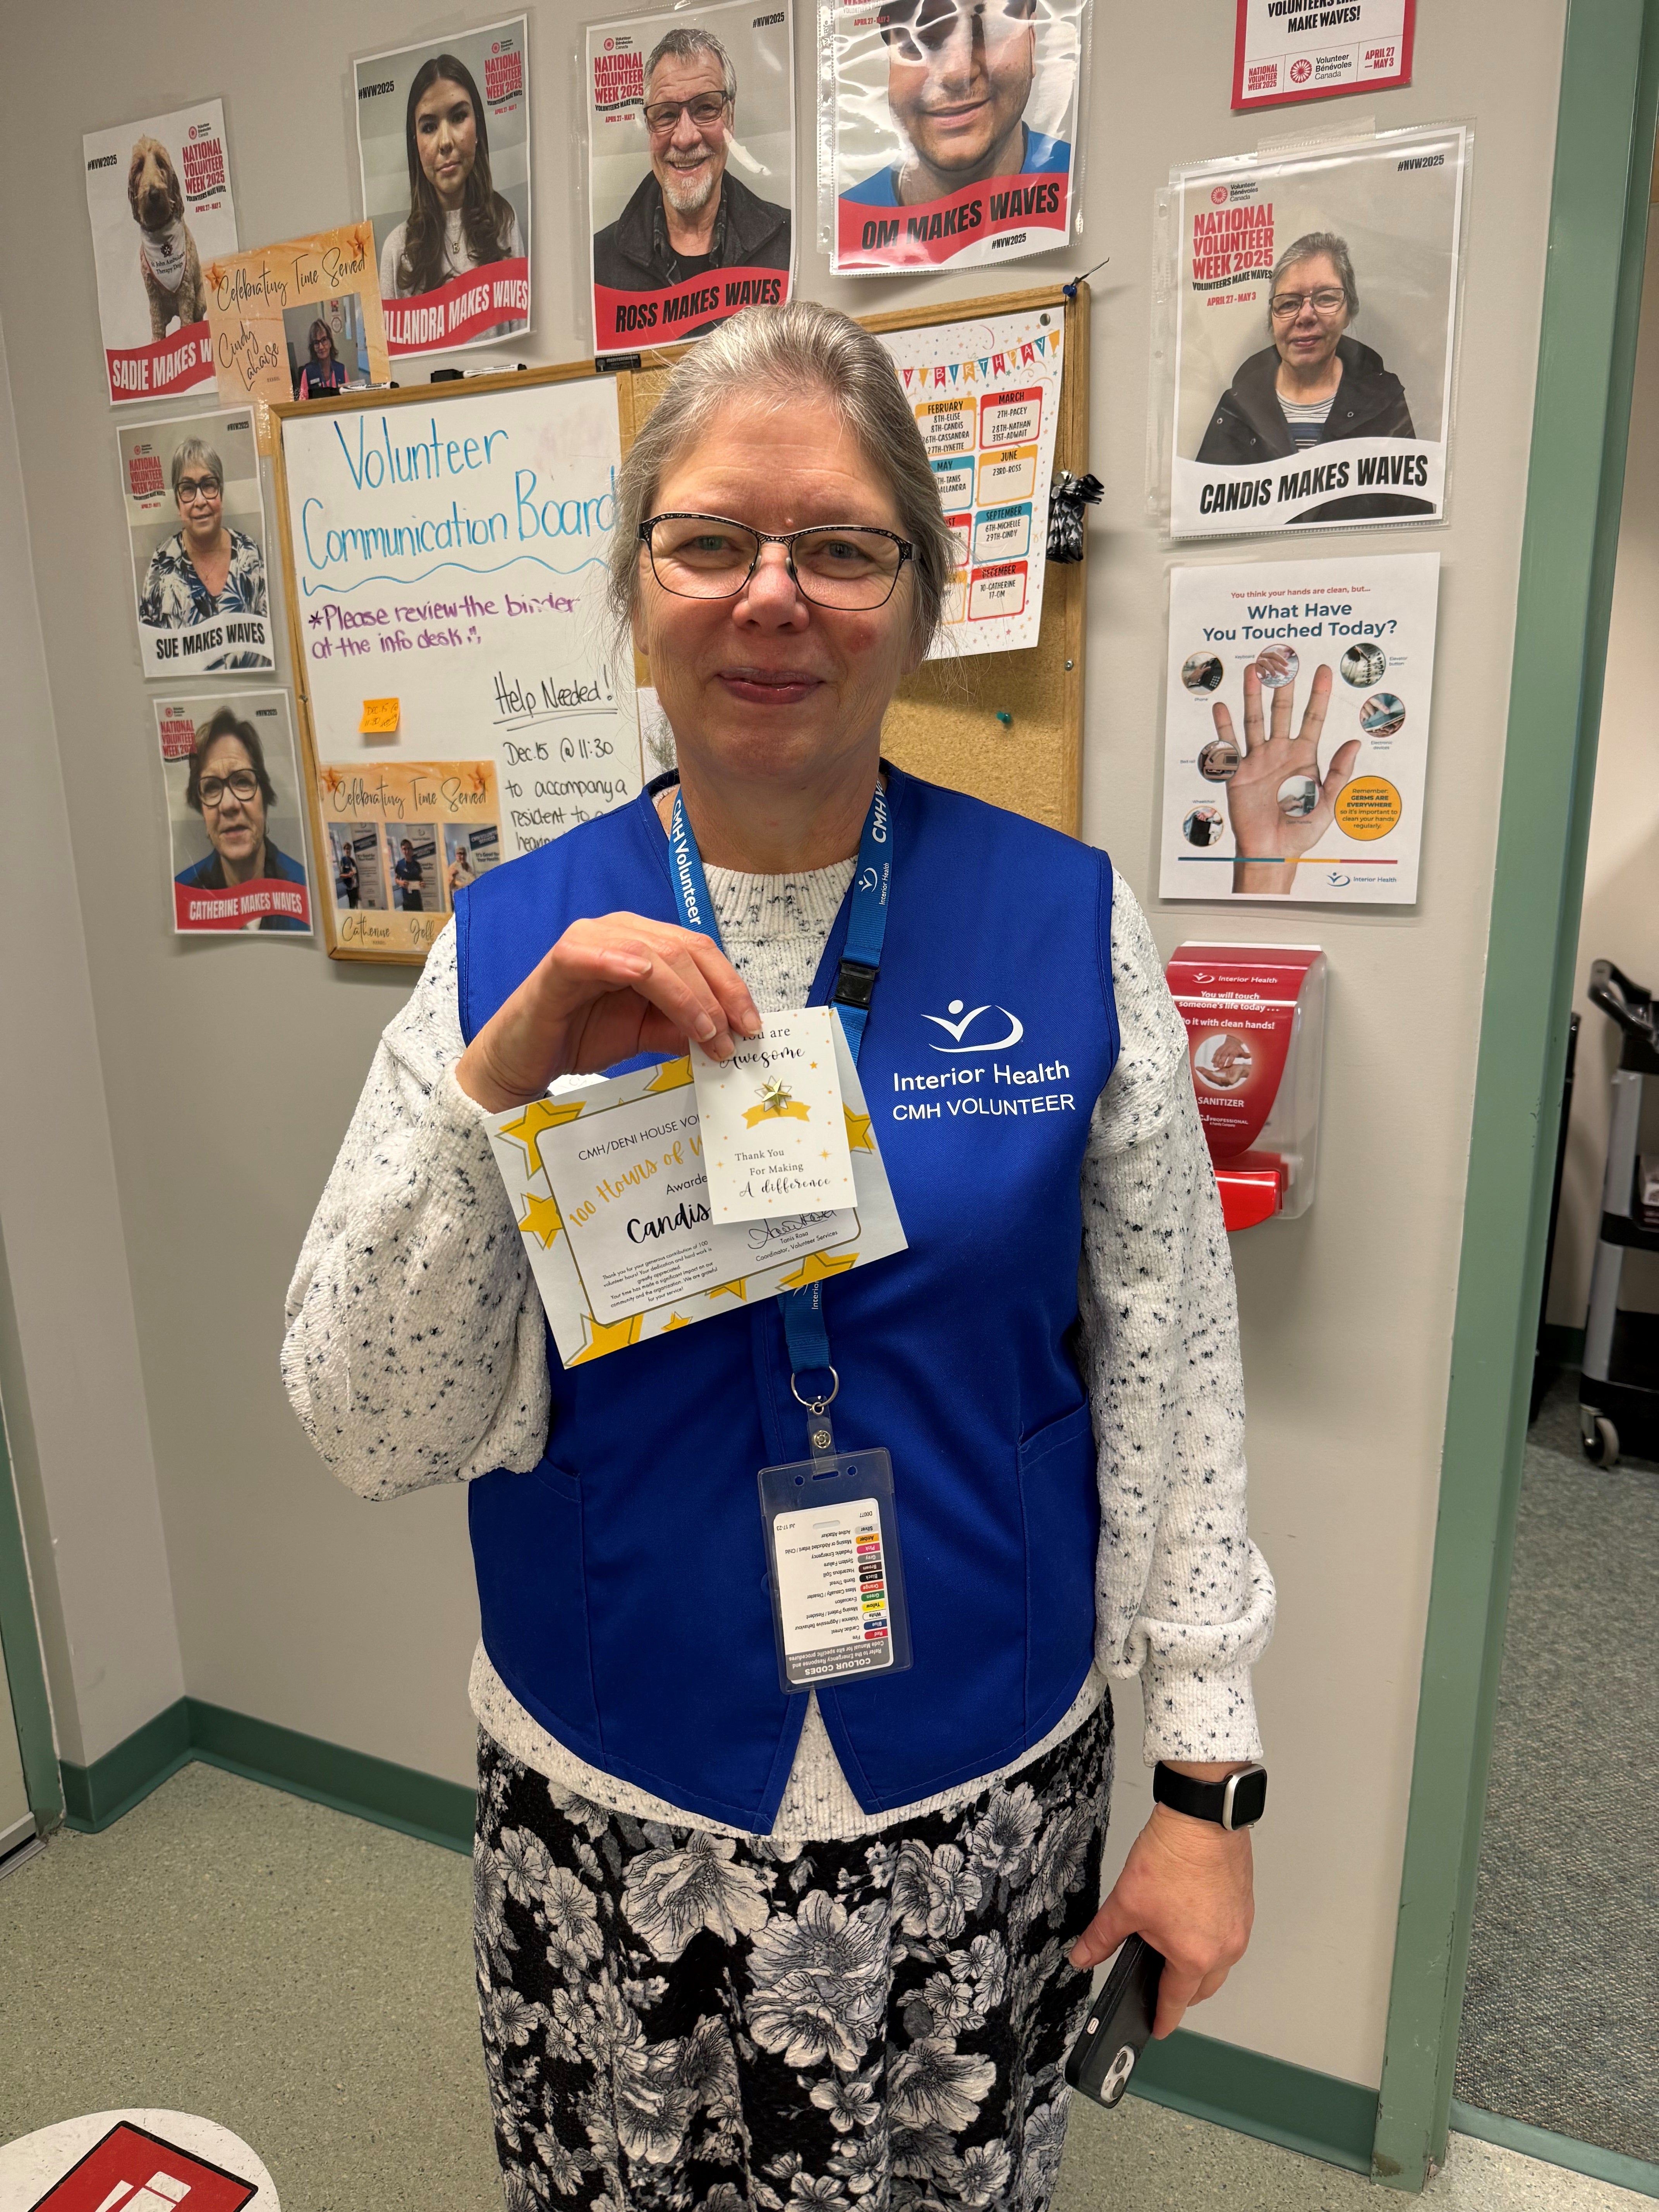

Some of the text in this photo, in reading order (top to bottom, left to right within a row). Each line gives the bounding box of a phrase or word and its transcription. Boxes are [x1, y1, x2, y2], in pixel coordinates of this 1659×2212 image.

[752, 12, 784, 28] #NVW2025
[1288, 5, 1360, 33] MAKE WAVES!
[594, 52, 643, 74] NATIONAL
[1316, 54, 1349, 64] Volunteer
[1365, 47, 1395, 60] APRIL 27
[1374, 58, 1394, 69] MAY 3
[1249, 64, 1277, 76] NATIONAL
[1315, 71, 1341, 80] Canada
[1316, 61, 1352, 72] Bénévoles
[594, 68, 643, 88] VOLUNTEER
[1248, 79, 1277, 91] WEEK 2025
[1249, 73, 1277, 83] VOLUNTEER
[358, 81, 394, 100] #NVW2025
[594, 82, 644, 104] WEEK 2025
[182, 138, 222, 164] NATIONAL
[87, 155, 117, 170] #NVW2025
[184, 155, 223, 178] VOLUNTEER
[1397, 155, 1444, 172] #NVW2025
[185, 170, 225, 194] WEEK 2025
[862, 182, 1060, 250] OM MAKES WAVES
[1194, 203, 1274, 236] NATIONAL
[992, 233, 1026, 250] #NVW2025
[1194, 228, 1274, 258] VOLUNTEER
[1193, 248, 1273, 280] WEEK 2025
[217, 247, 365, 313] Celebrating Time Served
[1192, 270, 1273, 291] VOLUNTEERS MAKE WAVES
[449, 284, 489, 333] MAKES
[493, 280, 528, 310] WAVES
[616, 278, 781, 333] ROSS MAKES WAVES
[218, 321, 256, 368] Cindy
[113, 359, 149, 391] SADIE
[153, 343, 196, 388] MAKES
[936, 338, 1044, 379] BIRTHDAY
[928, 401, 963, 415] FEBRUARY
[999, 392, 1024, 404] MARCH
[934, 412, 960, 423] 8TH-ELISE
[998, 407, 1027, 419] 2TH-PACEY
[931, 422, 963, 433] 8TH-CANDIS
[992, 420, 1030, 433] 28TH-NATHAN
[334, 416, 508, 490] Volunteer
[1001, 451, 1018, 462] JUNE
[937, 461, 953, 471] MAY
[993, 464, 1021, 476] 23RD-ROSS
[1200, 455, 1428, 515] CANDIS MAKES WAVES
[302, 466, 618, 570] Communication Board
[986, 506, 1022, 521] SEPTEMBER
[986, 530, 1018, 542] 29TH-CINDY
[982, 565, 1016, 578] DECEMBER
[395, 601, 459, 623] review
[459, 595, 499, 616] the
[1247, 603, 1352, 620] What Have
[156, 622, 265, 659] SUE MAKES WAVES
[1203, 620, 1397, 642] You Touched Today?
[312, 627, 462, 659] at the info desk
[495, 672, 536, 718] Help
[561, 738, 574, 762] @
[579, 738, 613, 759] 11:30
[505, 780, 627, 802] to accompany a
[511, 805, 589, 827] resident to
[872, 797, 888, 843] CMH
[673, 799, 701, 926] CMH Volunteer
[879, 863, 890, 905] Interior Health
[190, 892, 302, 921] CATHERINE MAKES WAVES
[1200, 991, 1216, 999] You
[1179, 1001, 1266, 1012] someone's life today
[770, 1028, 791, 1037] are
[1200, 1018, 1218, 1026] with
[1220, 1019, 1243, 1028] clean
[1245, 1021, 1275, 1030] hands!
[720, 1047, 805, 1070] Awesome
[894, 1060, 1069, 1091] Interior Health
[893, 1094, 1075, 1120] CMH VOLUNTEER
[1198, 1097, 1244, 1108] SANITIZER
[579, 1121, 678, 1160] CMH/DENI HOUSE
[735, 1152, 764, 1161] Thank
[750, 1163, 804, 1176] For Making
[569, 1140, 684, 1227] 100 Hours of
[739, 1178, 830, 1198] A difference
[627, 1203, 711, 1243] Candis
[756, 1231, 838, 1261] Coordinator, Volunteer Services
[805, 1658, 871, 1675] COLOUR CODES
